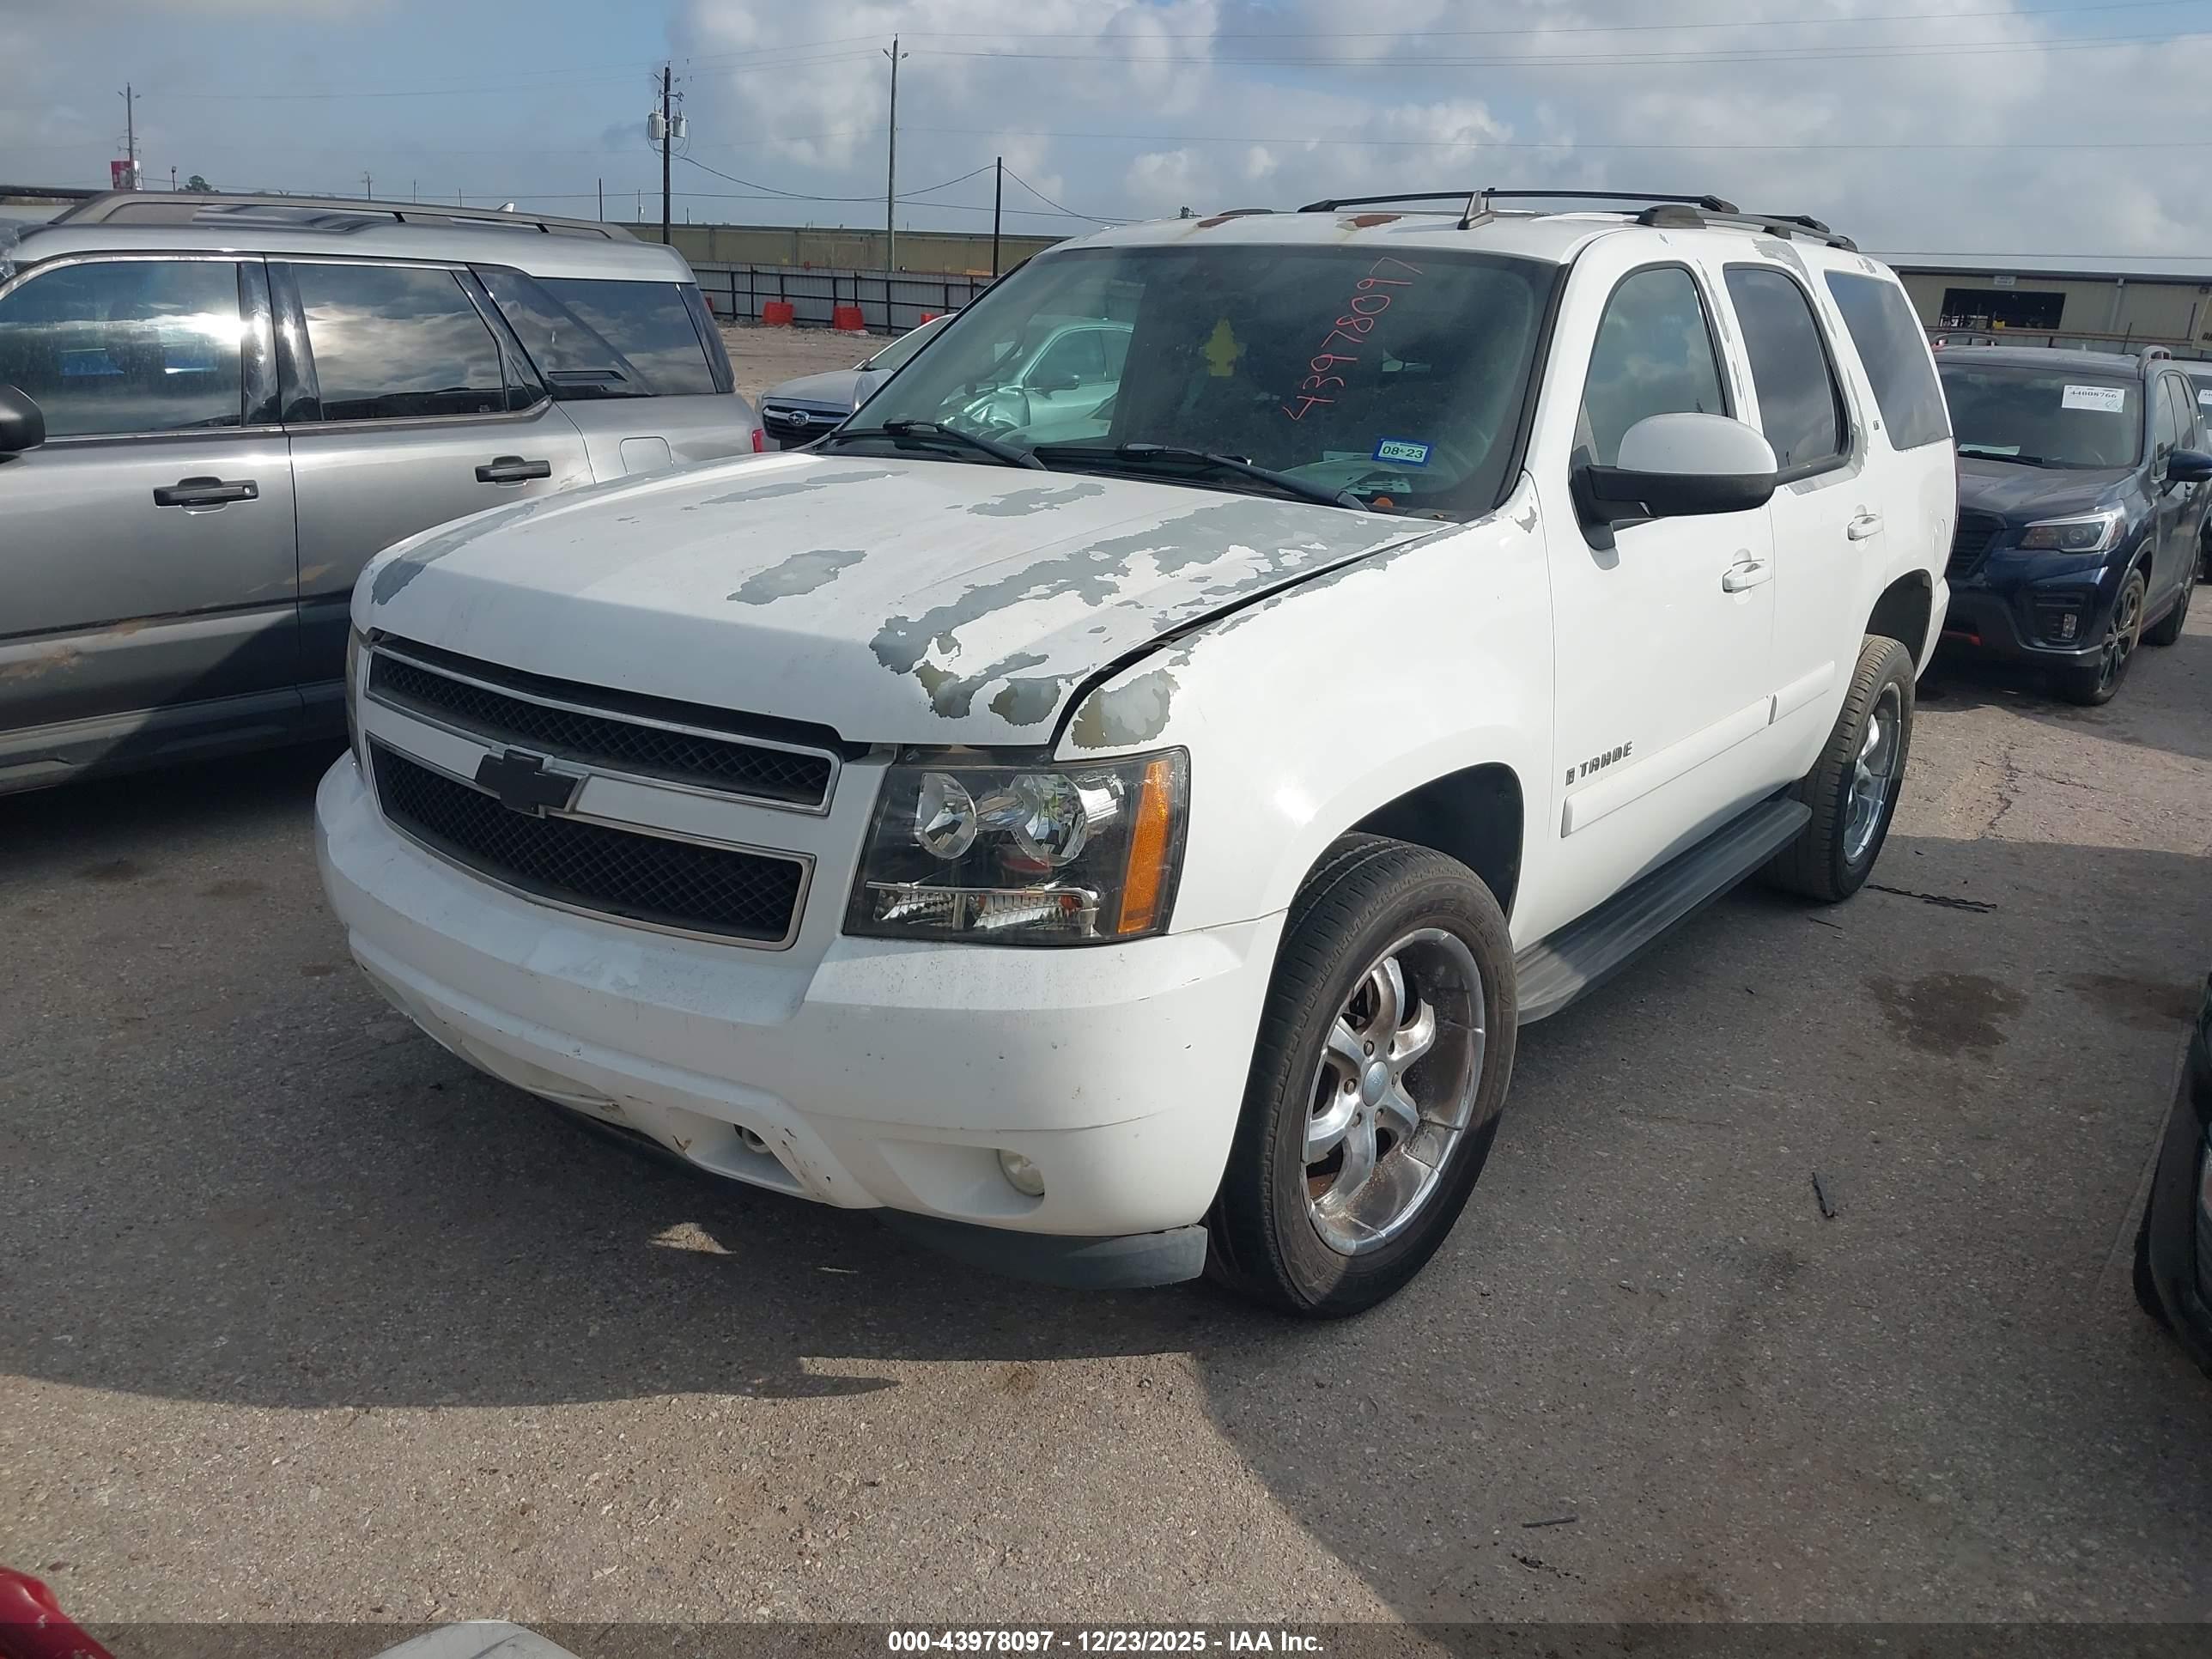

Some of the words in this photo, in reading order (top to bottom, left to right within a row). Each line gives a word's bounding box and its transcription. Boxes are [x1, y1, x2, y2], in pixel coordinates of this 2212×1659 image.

[1282, 256, 1424, 421] 43978097
[1382, 446, 1400, 455] 08
[1406, 448, 1423, 459] 23
[1579, 740, 1632, 778] TAHOE
